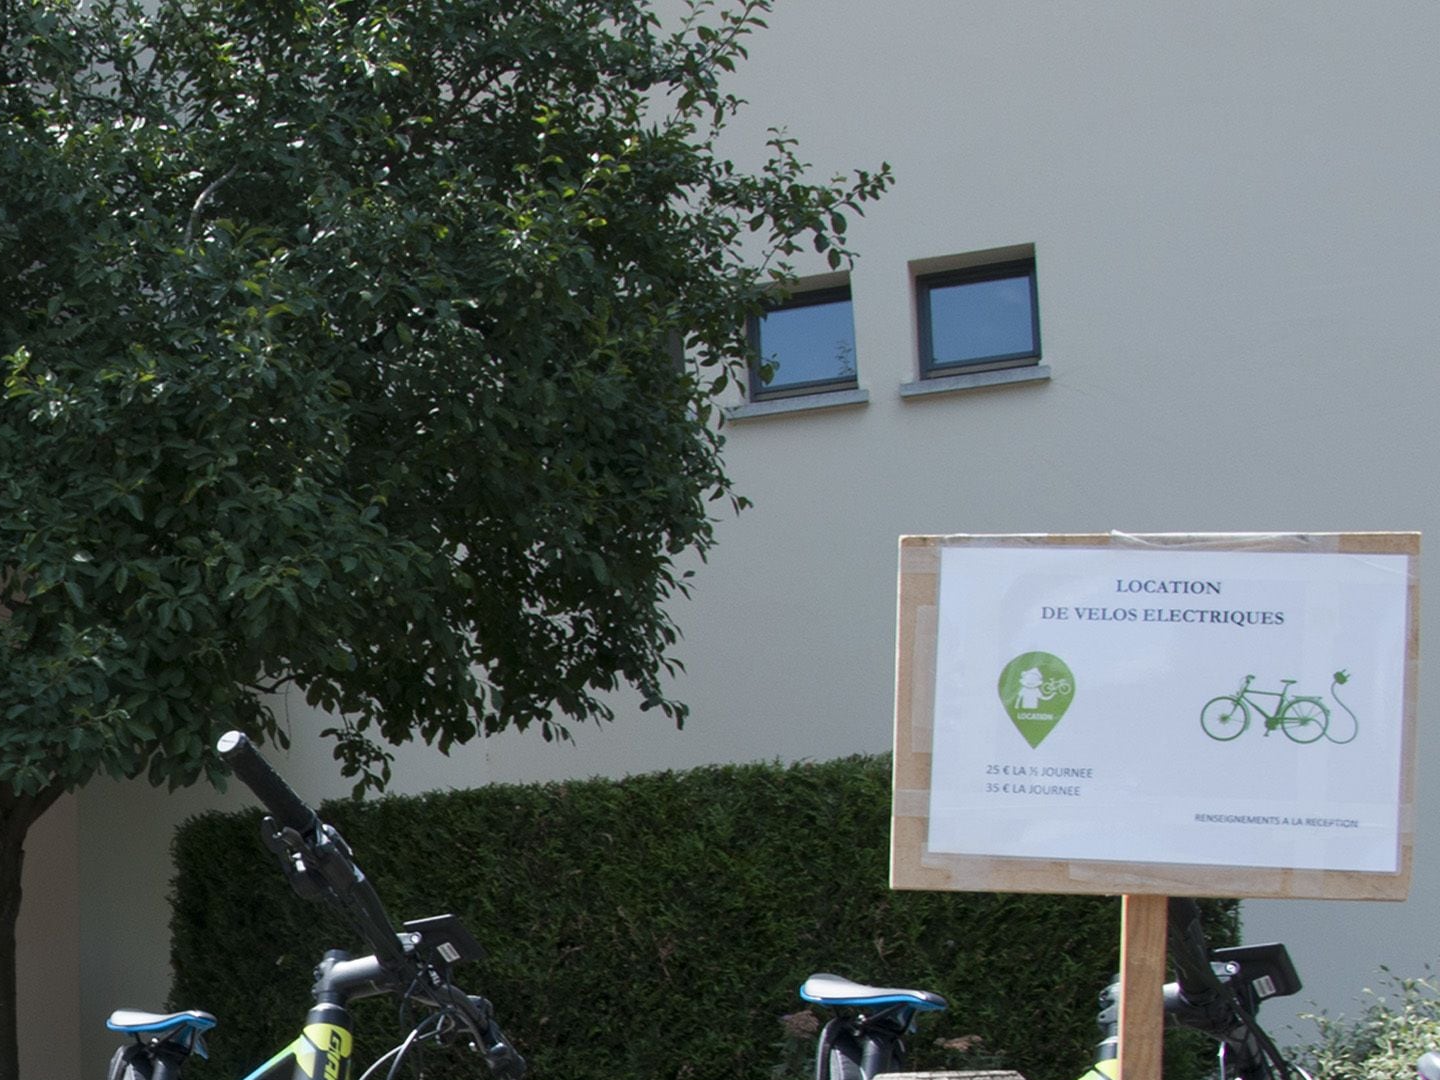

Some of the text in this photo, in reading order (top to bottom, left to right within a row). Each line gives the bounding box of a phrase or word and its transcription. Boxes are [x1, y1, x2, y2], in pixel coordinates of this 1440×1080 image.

[1116, 579, 1222, 595] LOCATION
[1041, 606, 1285, 627] DE VELOS ELECTRIQUES
[1016, 712, 1054, 721] LOCATION
[986, 764, 1000, 776] 25
[1003, 765, 1010, 776] €
[1012, 766, 1027, 776] LA
[1041, 766, 1094, 779] JOURNEE
[986, 782, 1081, 796] 35 € LA JOURNEE
[1194, 813, 1281, 826] RENSEIGNEMENTS
[1291, 817, 1304, 827] LA
[1305, 818, 1359, 829] RECEPTION
